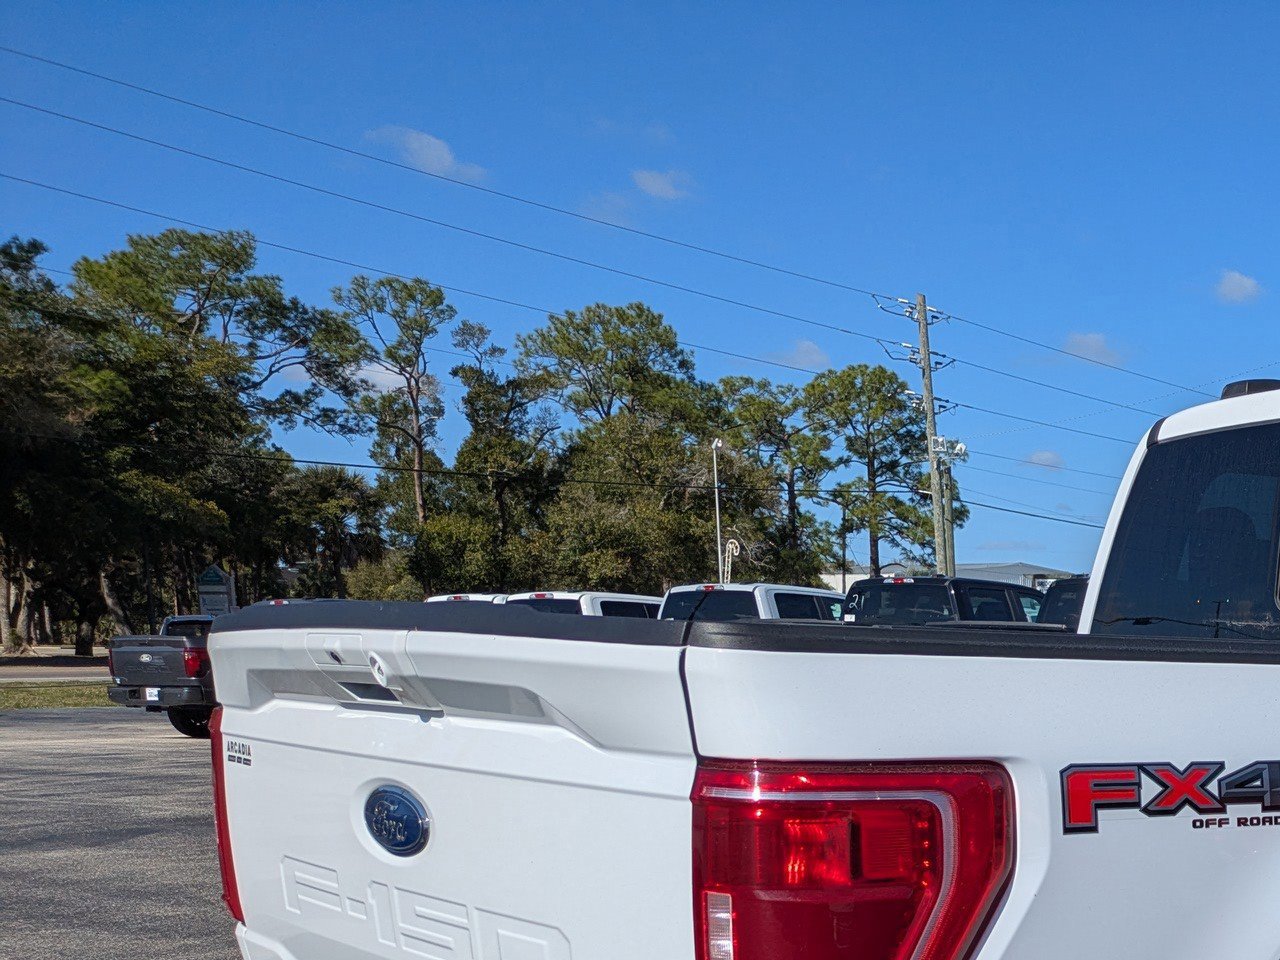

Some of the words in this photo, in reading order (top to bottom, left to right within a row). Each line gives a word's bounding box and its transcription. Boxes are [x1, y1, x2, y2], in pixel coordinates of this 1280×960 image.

[227, 740, 252, 757] ARCADIA
[372, 800, 408, 843] Ford
[1192, 818, 1230, 829] OFF
